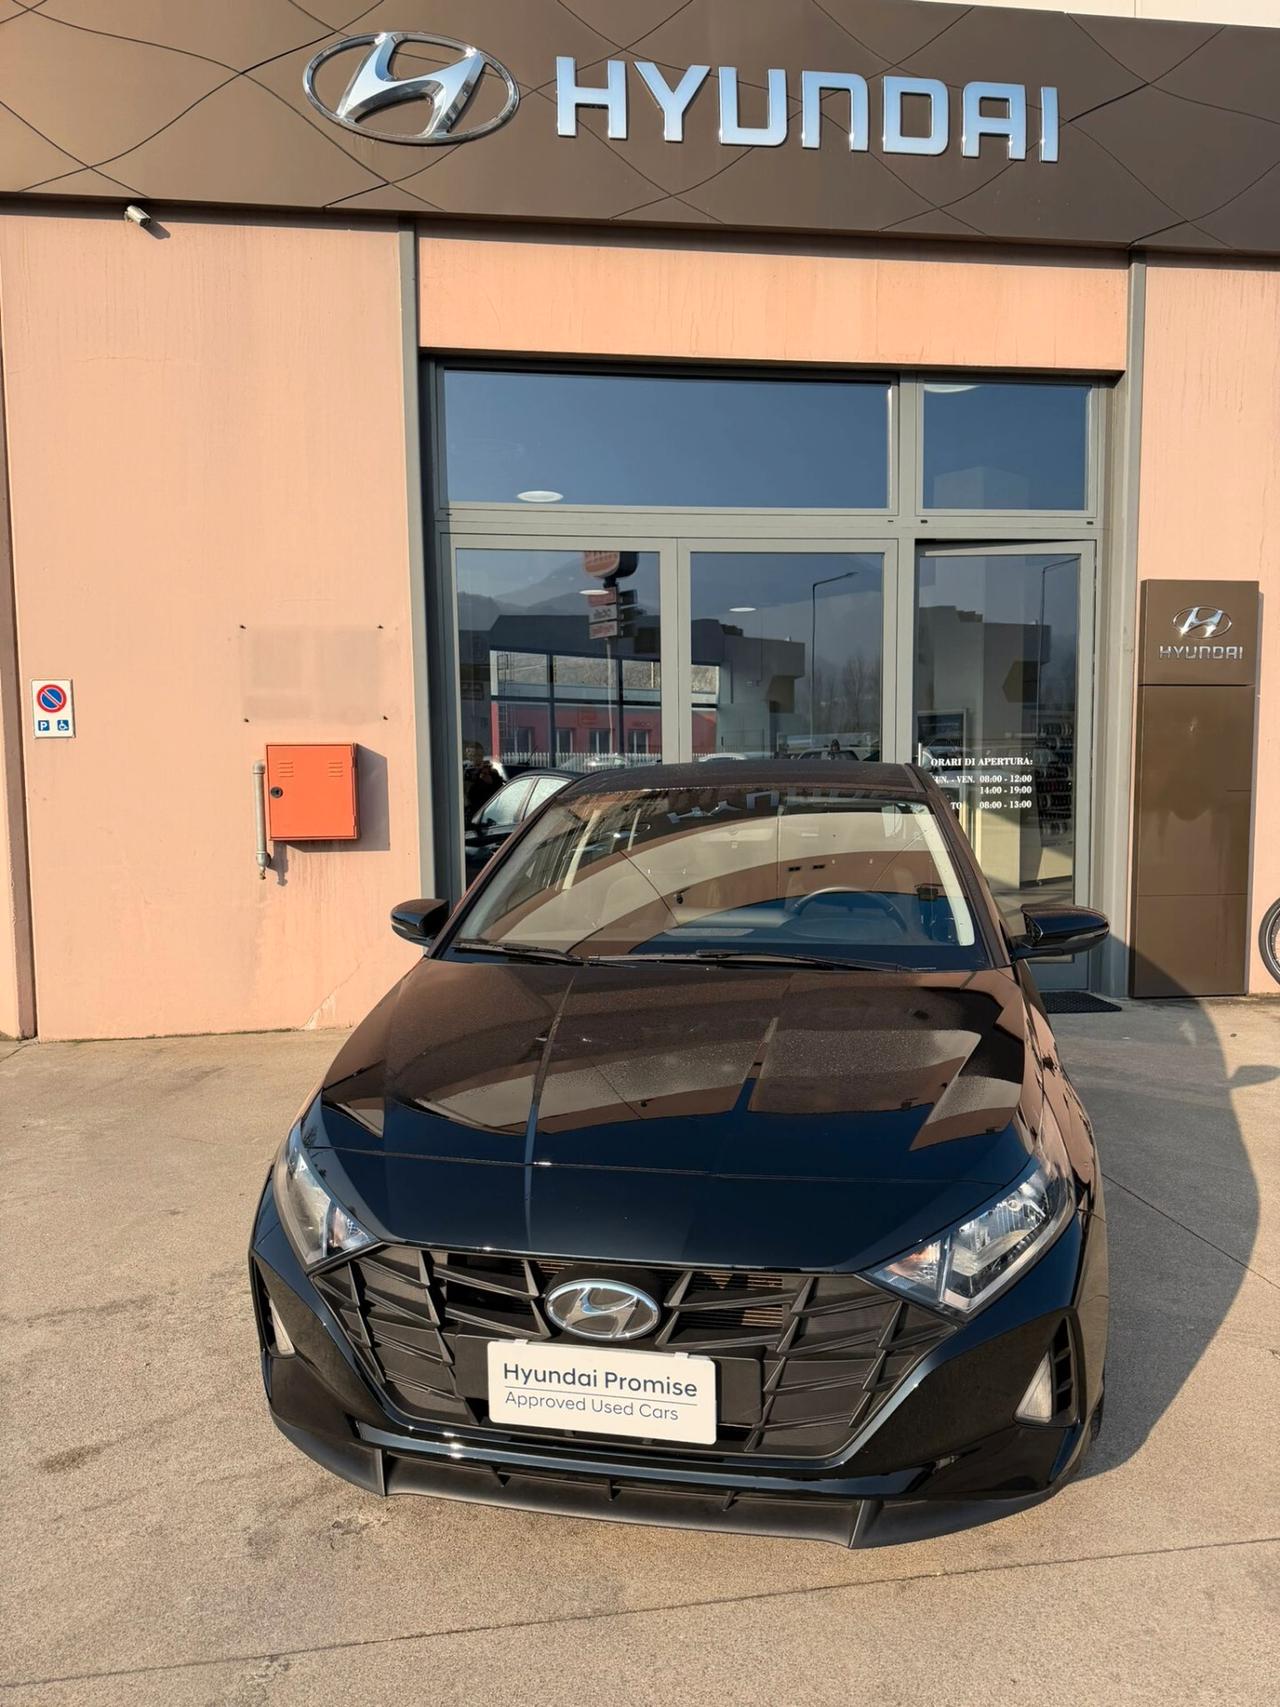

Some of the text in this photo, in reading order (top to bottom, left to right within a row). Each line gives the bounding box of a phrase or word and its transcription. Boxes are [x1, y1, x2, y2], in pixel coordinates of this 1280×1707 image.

[556, 56, 1059, 162] HYUNDAI
[1159, 645, 1243, 660] HYUNDAI
[40, 721, 48, 730] P
[930, 757, 1033, 766] ORARI DI APERTURA:
[932, 775, 949, 785] UN.
[956, 775, 975, 784] VEN.
[979, 774, 1002, 783] 08:00
[1010, 774, 1032, 783] 12:00
[980, 786, 1002, 795] 14:00
[1010, 785, 1032, 794] 19:00
[979, 801, 1002, 809] 08:00
[1010, 800, 1032, 809] 13:00
[503, 1363, 697, 1397] Hyundai Promise
[505, 1391, 679, 1421] Approved Used Cars
